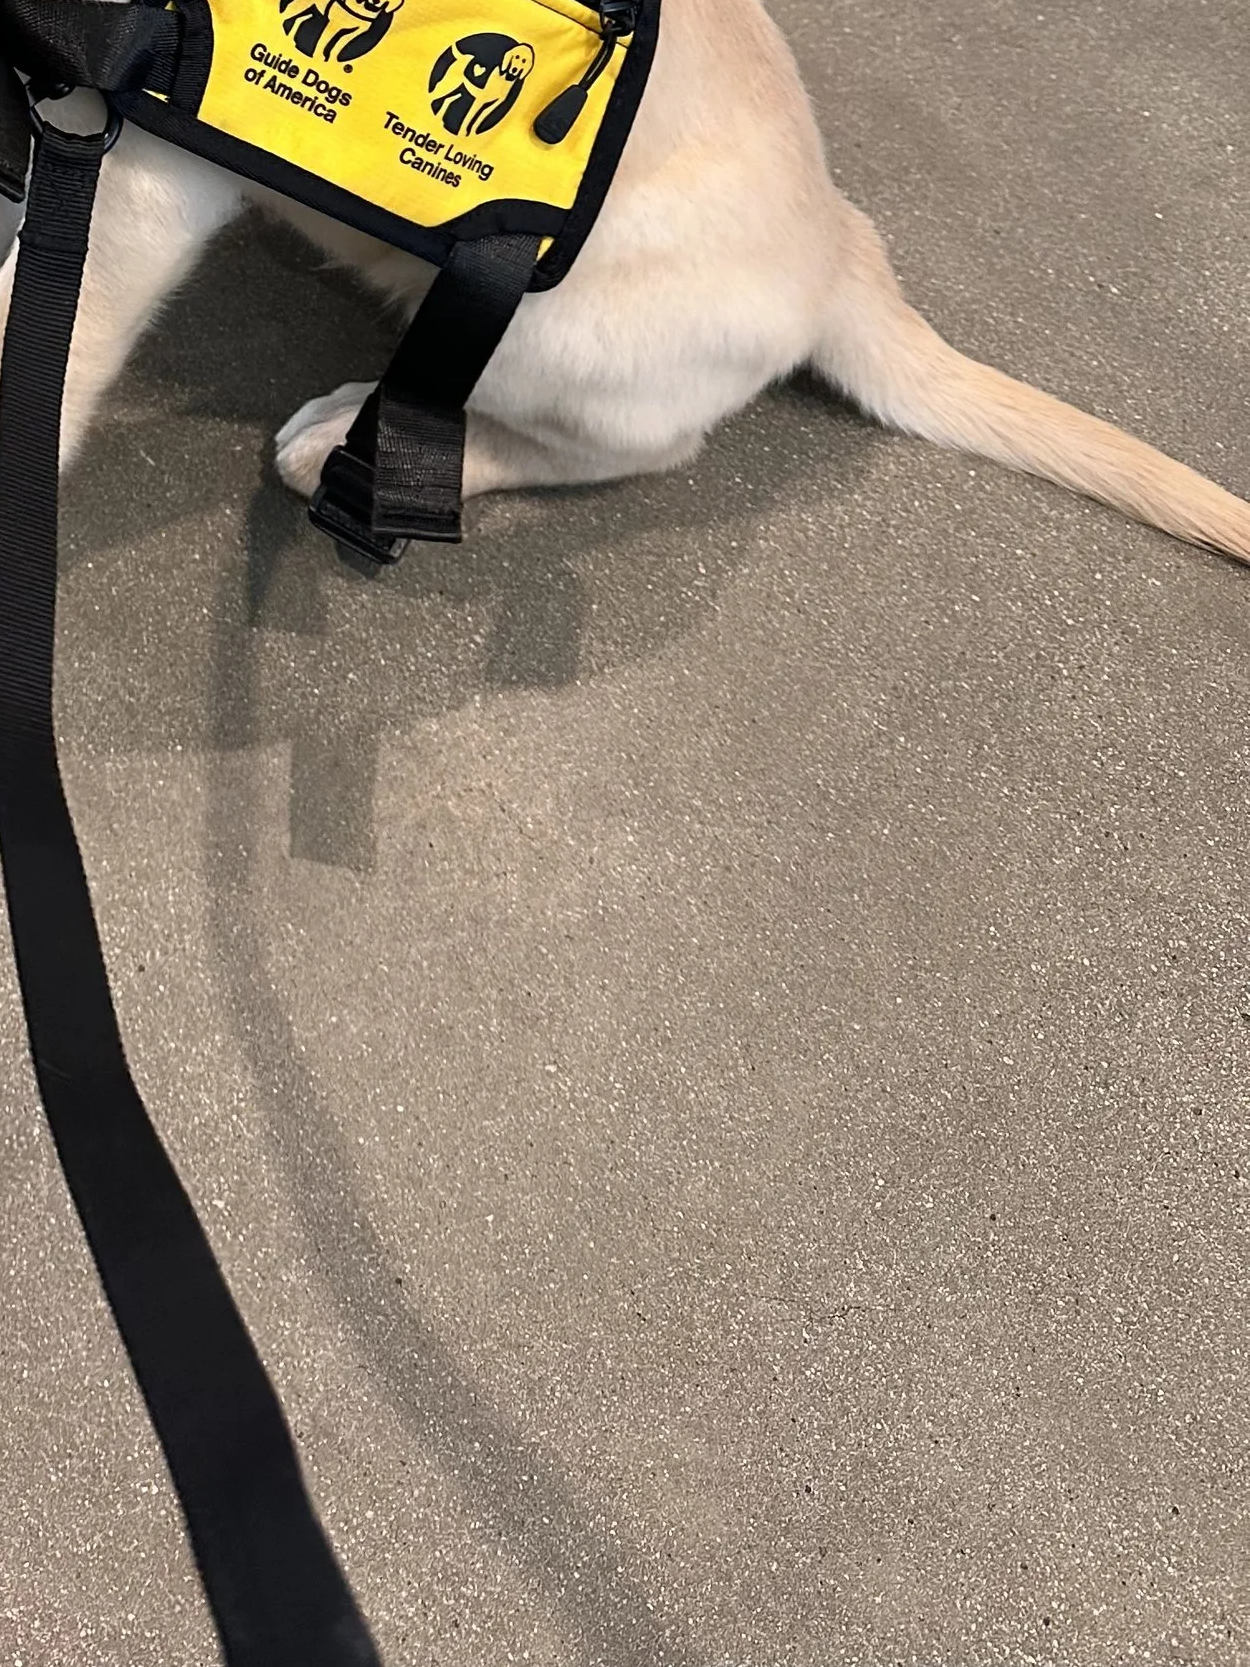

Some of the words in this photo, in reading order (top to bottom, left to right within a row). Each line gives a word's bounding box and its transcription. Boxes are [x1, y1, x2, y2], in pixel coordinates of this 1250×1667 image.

[244, 68, 265, 85] of
[263, 77, 337, 123] America
[251, 42, 299, 78] Guide
[302, 69, 352, 106] Dogs
[383, 111, 444, 154] Tender
[444, 145, 494, 181] Loving
[400, 148, 461, 187] Canines
